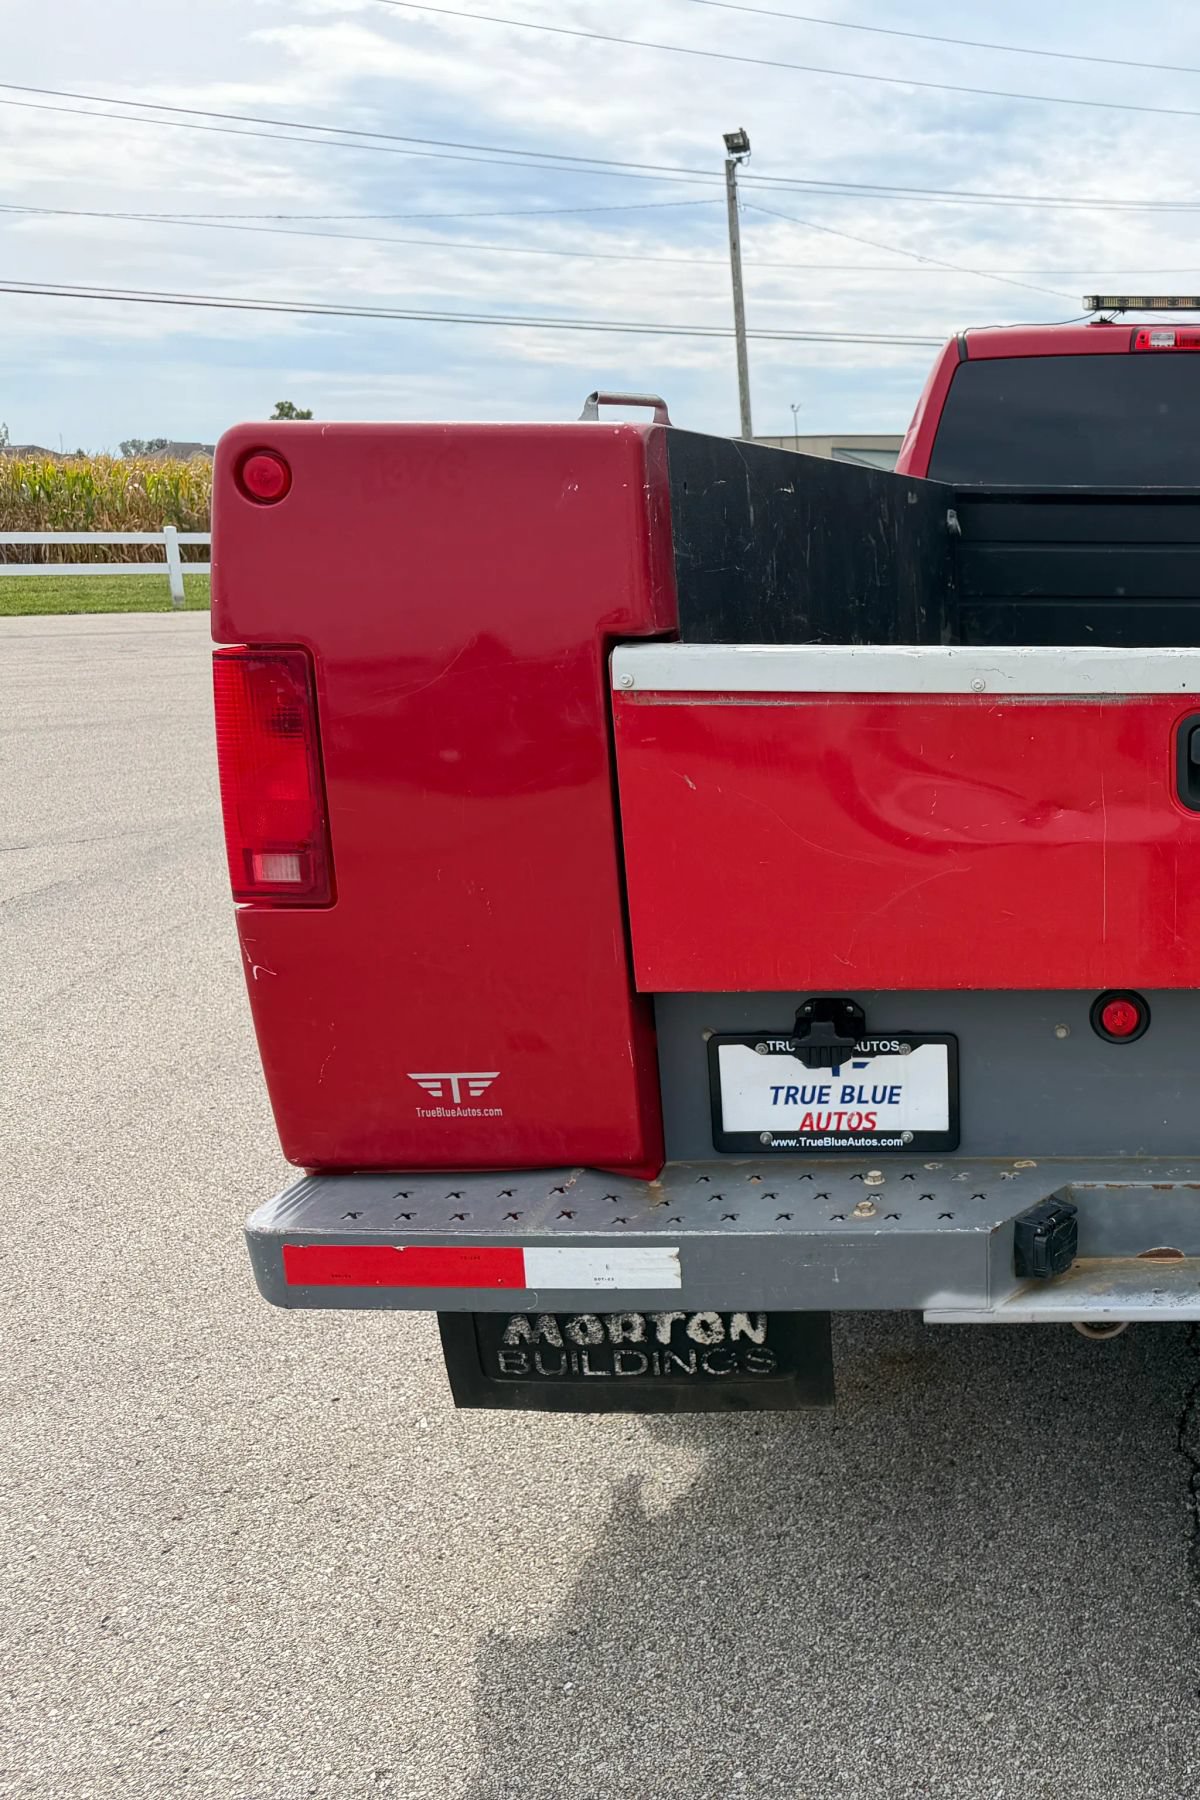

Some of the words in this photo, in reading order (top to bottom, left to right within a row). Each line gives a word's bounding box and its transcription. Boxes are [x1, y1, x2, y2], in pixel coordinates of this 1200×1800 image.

[766, 1041, 796, 1052] TRU
[770, 1085, 831, 1105] TRUE
[840, 1085, 902, 1105] BLUE
[416, 1107, 503, 1118] TrueBlueAutos.com
[800, 1111, 877, 1132] AUTOS
[771, 1136, 903, 1147] www.TrueBlueAutos.com
[503, 1311, 768, 1347] MORTON
[498, 1347, 777, 1376] BUILDINGS
